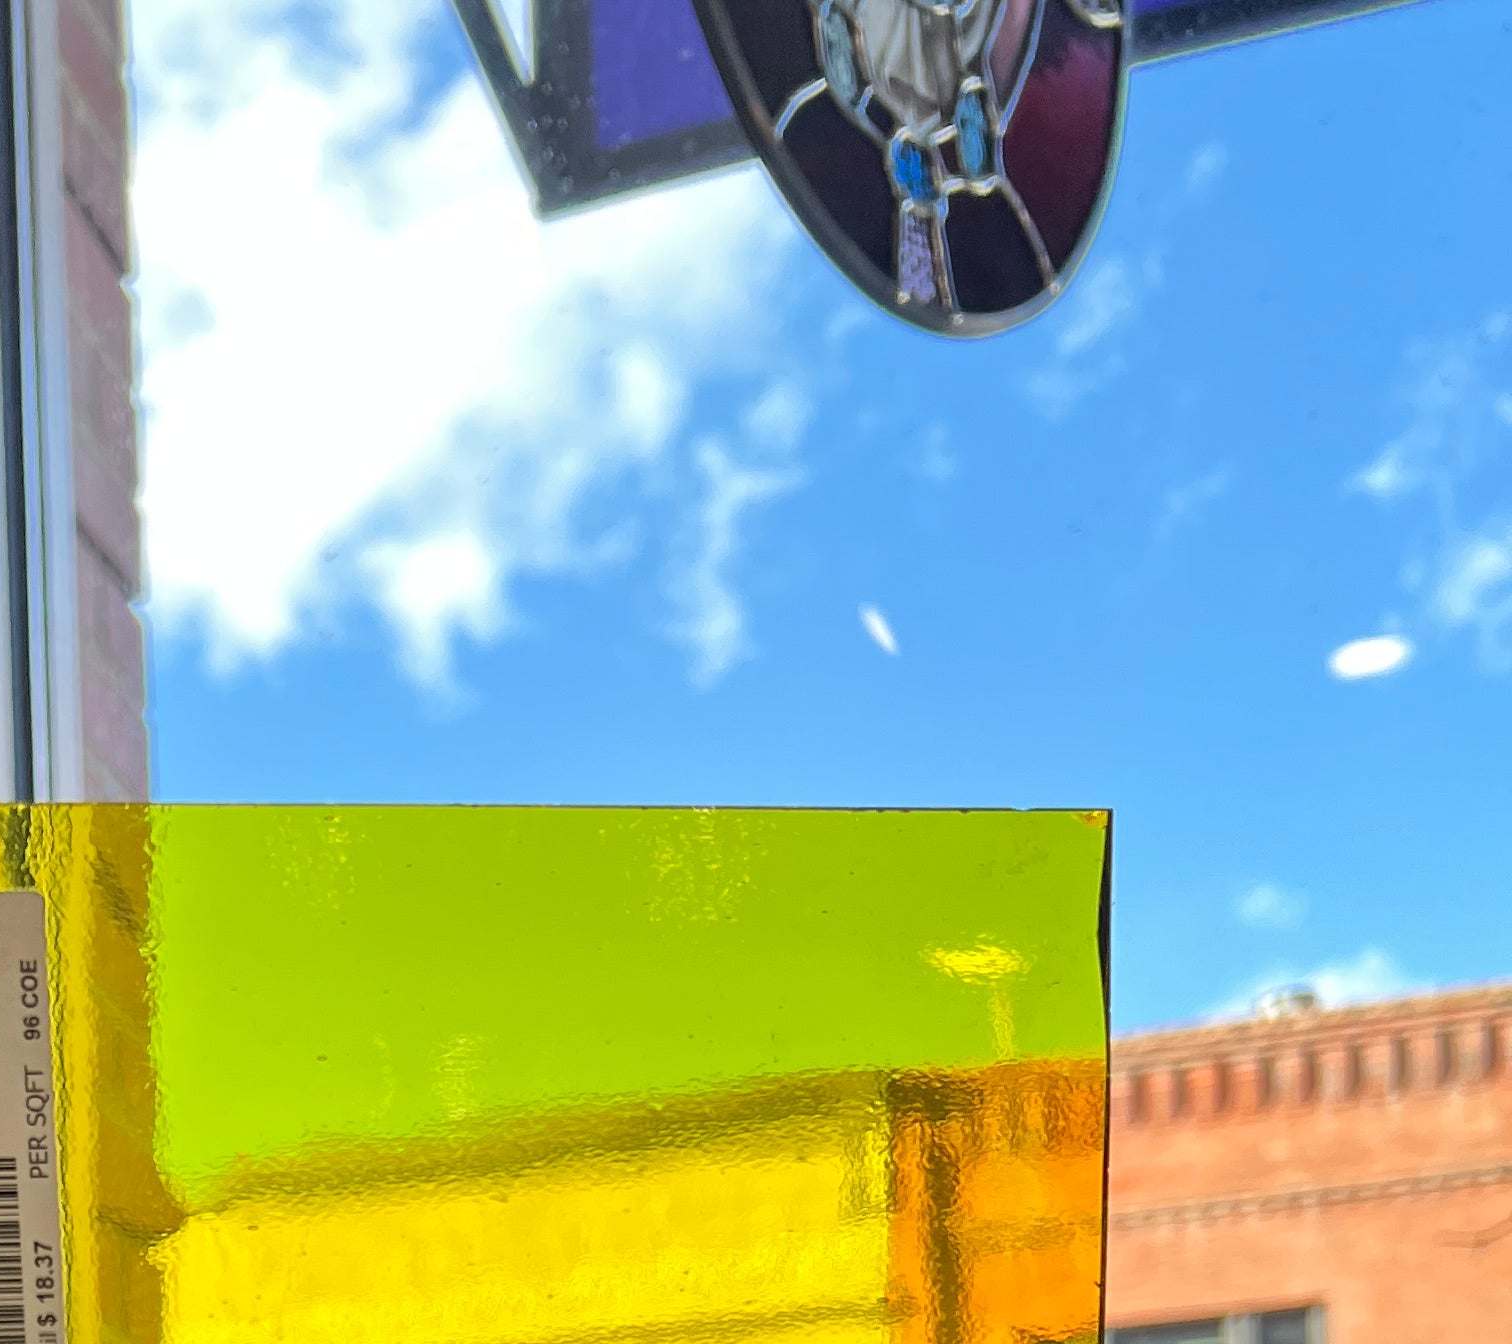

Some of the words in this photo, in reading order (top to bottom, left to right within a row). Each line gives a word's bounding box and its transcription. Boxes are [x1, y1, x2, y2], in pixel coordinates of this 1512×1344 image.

[19, 959, 39, 1009] COE
[22, 1015, 40, 1041] 96
[25, 1065, 49, 1129] SQFT
[28, 1135, 50, 1180] PER
[33, 1240, 57, 1304] 18.37
